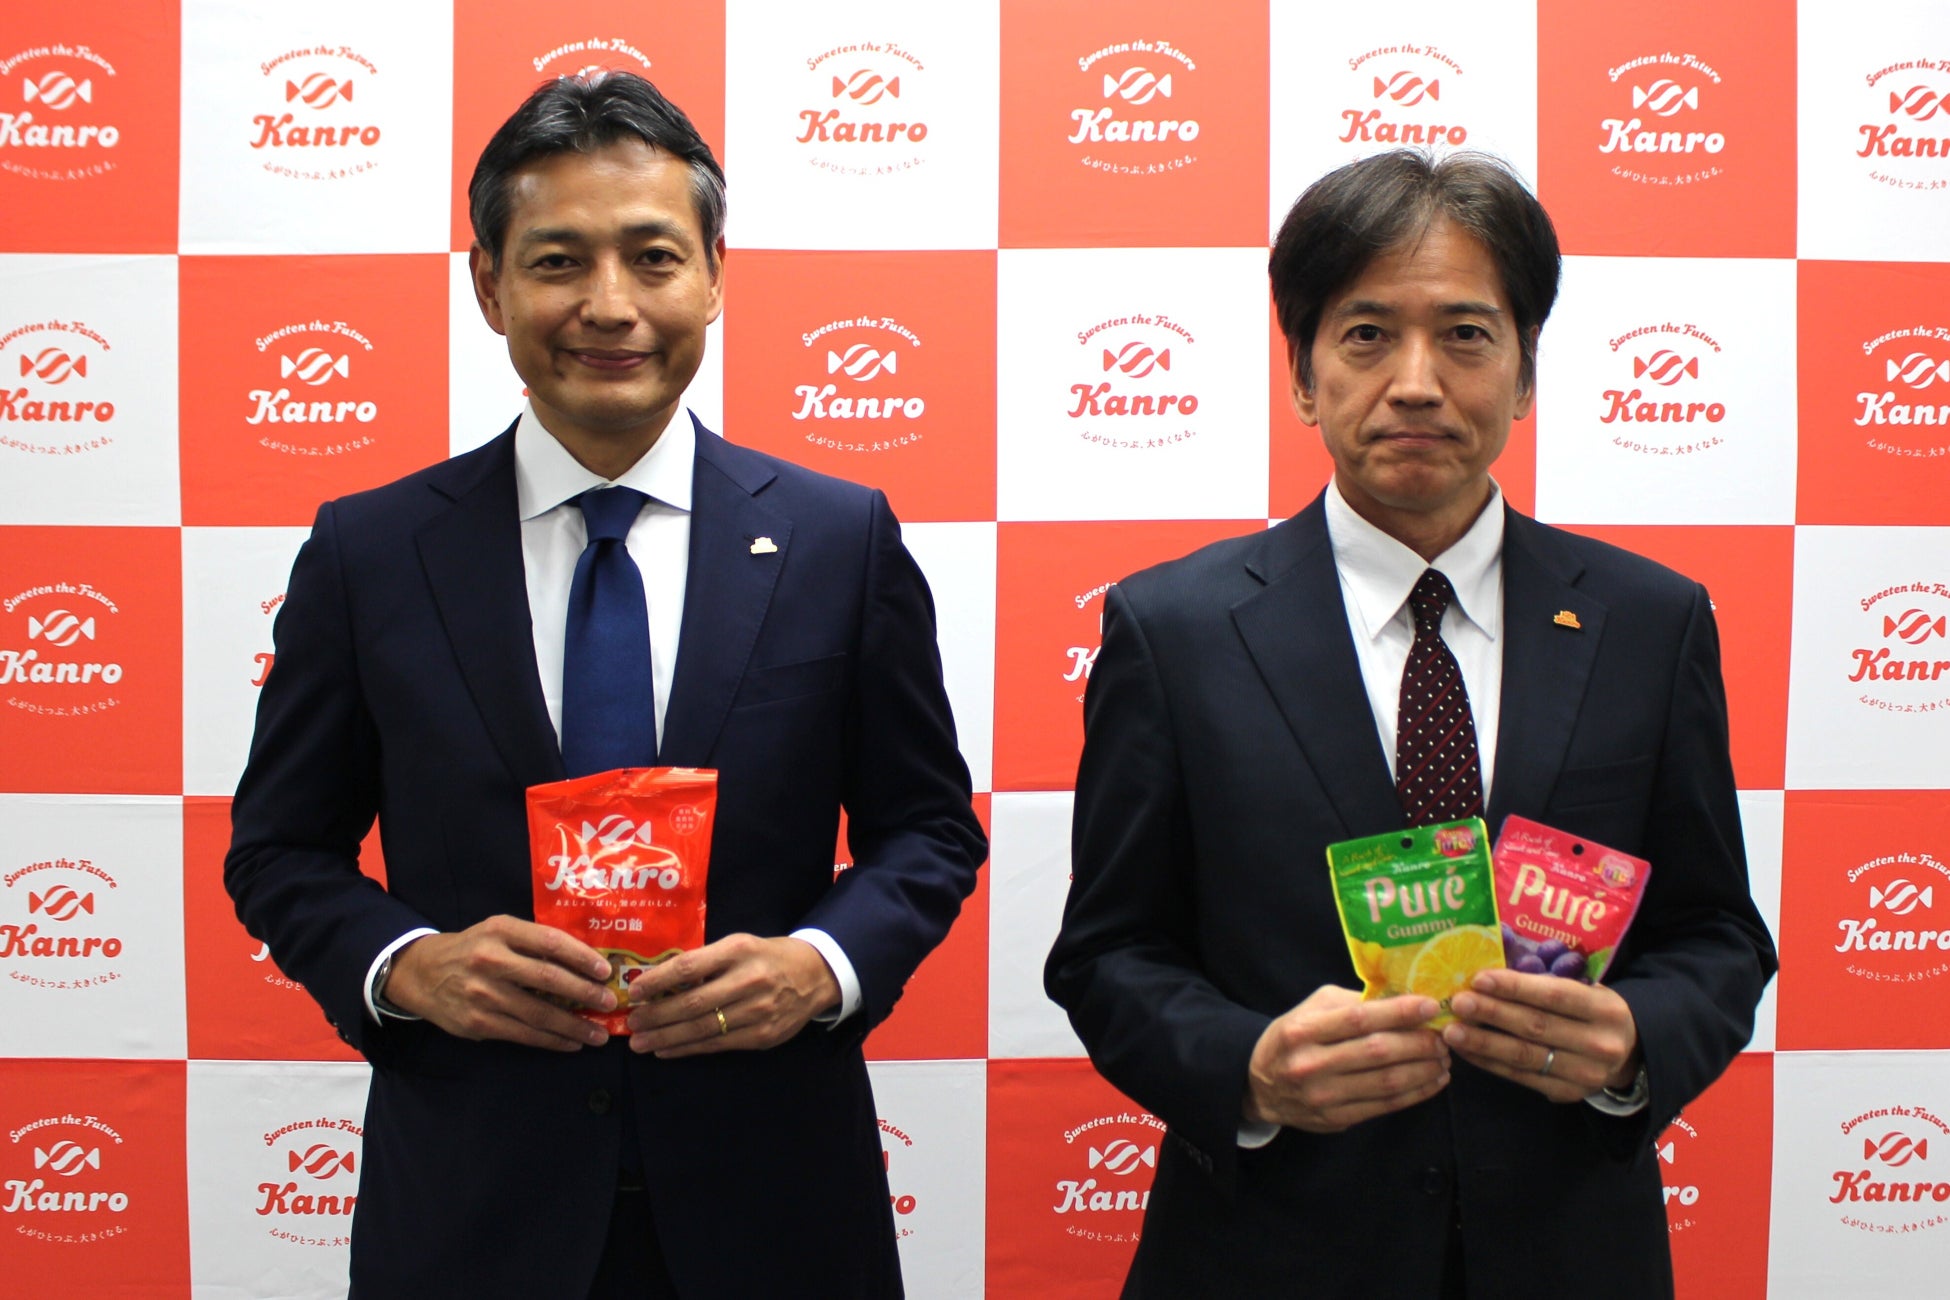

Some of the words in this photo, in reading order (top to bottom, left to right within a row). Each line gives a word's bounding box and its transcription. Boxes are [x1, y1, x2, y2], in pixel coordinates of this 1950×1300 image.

[260, 49, 311, 76] Sweeten
[314, 45, 335, 56] the
[337, 46, 377, 75] Future
[532, 41, 585, 72] Sweeten
[587, 37, 609, 50] the
[609, 38, 652, 69] Future
[807, 45, 857, 71] Sweeten
[861, 41, 881, 52] the
[885, 43, 924, 71] Future
[1078, 43, 1130, 72] Sweeten
[1132, 39, 1154, 52] the
[1154, 40, 1196, 71] Future
[1348, 46, 1398, 71] Sweeten
[1401, 43, 1421, 54] the
[1424, 45, 1463, 75] Future
[1608, 55, 1658, 83] Sweeten
[1659, 51, 1681, 64] the
[1681, 53, 1722, 84] Future
[1865, 61, 1914, 88] Sweeten
[1916, 58, 1936, 70] the
[249, 112, 381, 150] Kanro
[795, 108, 928, 144] Kanro
[1067, 106, 1200, 144] Kanro
[1338, 108, 1468, 146] Kanro
[1598, 118, 1725, 154] Kanro
[1856, 123, 1950, 158] Kanr
[255, 323, 307, 352] Sweeten
[309, 319, 331, 332] the
[331, 321, 373, 351] Future
[802, 319, 854, 347] Sweeten
[856, 315, 878, 328] the
[879, 317, 921, 347] Future
[1077, 317, 1129, 346] Sweeten
[1131, 313, 1152, 325] the
[1154, 315, 1195, 344] Future
[1609, 325, 1658, 353] Sweeten
[1660, 321, 1681, 334] the
[1682, 323, 1722, 353] Future
[1862, 329, 1911, 356] Sweeten
[1913, 325, 1933, 337] the
[245, 388, 377, 425] Kanro
[791, 383, 925, 420] Kanro
[1067, 381, 1199, 419] Kanro
[1599, 388, 1726, 424] Kanro
[1854, 391, 1950, 426] Kanr
[3, 585, 54, 613] Sweeten
[55, 582, 77, 594] the
[77, 583, 119, 614] Future
[1860, 585, 1909, 612] Sweeten
[1910, 581, 1931, 593] the
[0, 649, 123, 685] Kanro
[1847, 647, 1950, 683] Kanr
[3, 861, 53, 888] Sweeten
[55, 857, 76, 870] the
[76, 859, 117, 889] Future
[545, 854, 680, 890] Kanro
[1847, 856, 1895, 883] Sweeten
[1897, 852, 1917, 864] the
[1918, 853, 1950, 881] Futur
[1364, 866, 1465, 923] Puré
[1508, 863, 1606, 932] Puré
[0, 923, 123, 959] Kanro
[588, 917, 643, 932] カンロ飴
[1387, 917, 1458, 941] Gummy
[1514, 913, 1582, 950] Gummy
[9, 1117, 59, 1144] Sweeten
[61, 1113, 82, 1125] the
[82, 1115, 123, 1144] Future
[263, 1120, 314, 1147] Sweeten
[315, 1117, 337, 1129] the
[1063, 1116, 1114, 1144] Sweeten
[1116, 1112, 1138, 1124] the
[1840, 1108, 1889, 1135] Sweeten
[1891, 1105, 1911, 1117] the
[1911, 1106, 1950, 1135] Future
[2, 1178, 129, 1213] Kanro
[255, 1181, 356, 1216] Kanr
[1053, 1178, 1150, 1214] Kan
[1828, 1169, 1950, 1204] Kanro
